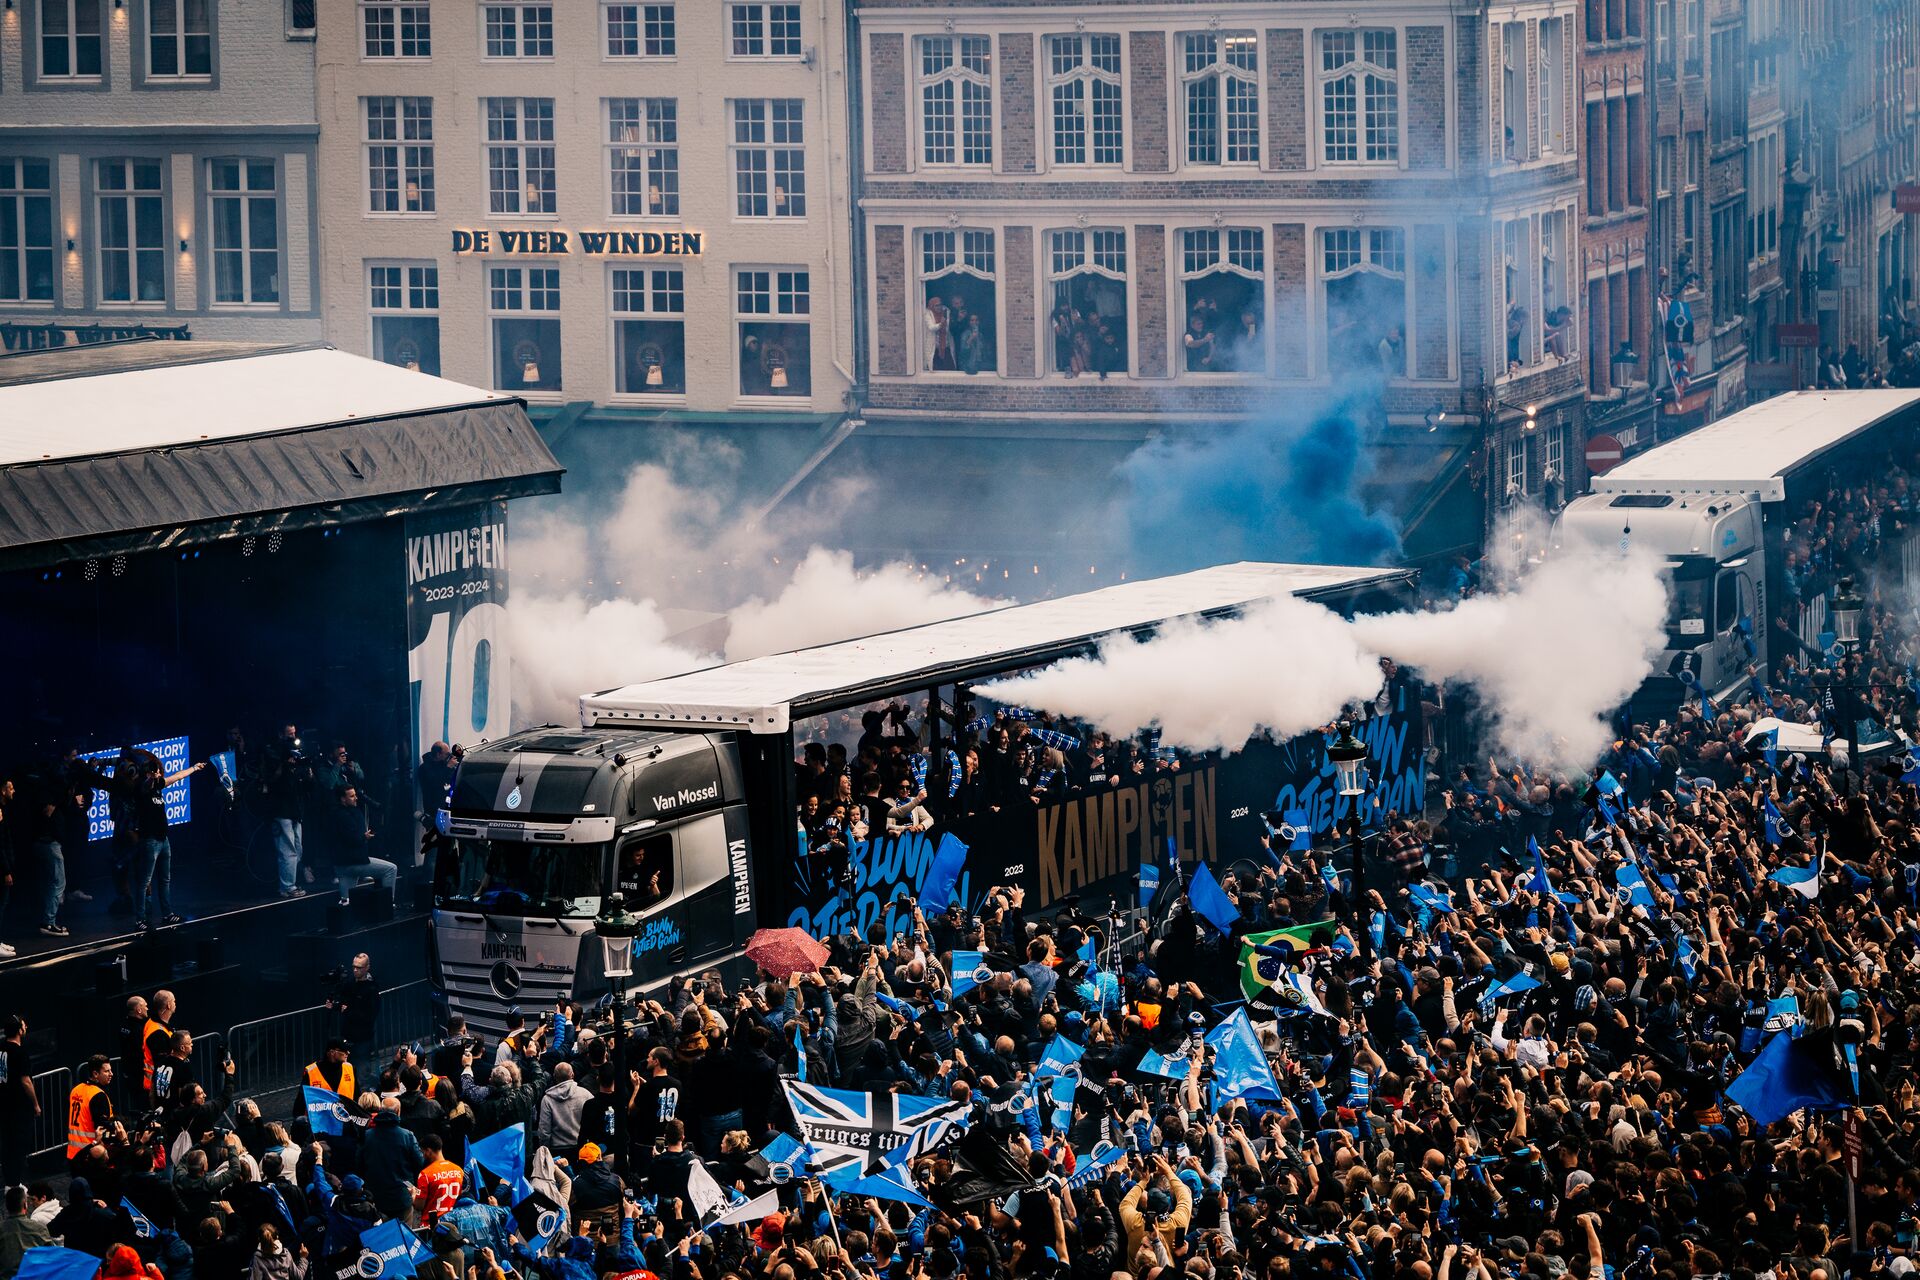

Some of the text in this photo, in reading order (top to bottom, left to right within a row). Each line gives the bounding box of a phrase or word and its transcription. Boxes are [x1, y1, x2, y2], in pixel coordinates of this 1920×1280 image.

[451, 230, 702, 255] DE VIER WINDEN
[425, 586, 454, 602] 2023
[461, 580, 490, 596] 2024
[408, 602, 512, 752] 10
[165, 758, 186, 774] ORY
[162, 789, 187, 805] ORY
[652, 781, 718, 811] Van Mossel
[166, 804, 188, 820] ORY
[1231, 807, 1249, 819] 2024
[1004, 864, 1024, 877] 2023
[70, 1101, 81, 1127] 12
[801, 1123, 872, 1148] Bruges
[433, 1169, 462, 1181] JACKERS
[436, 1182, 461, 1211] 29
